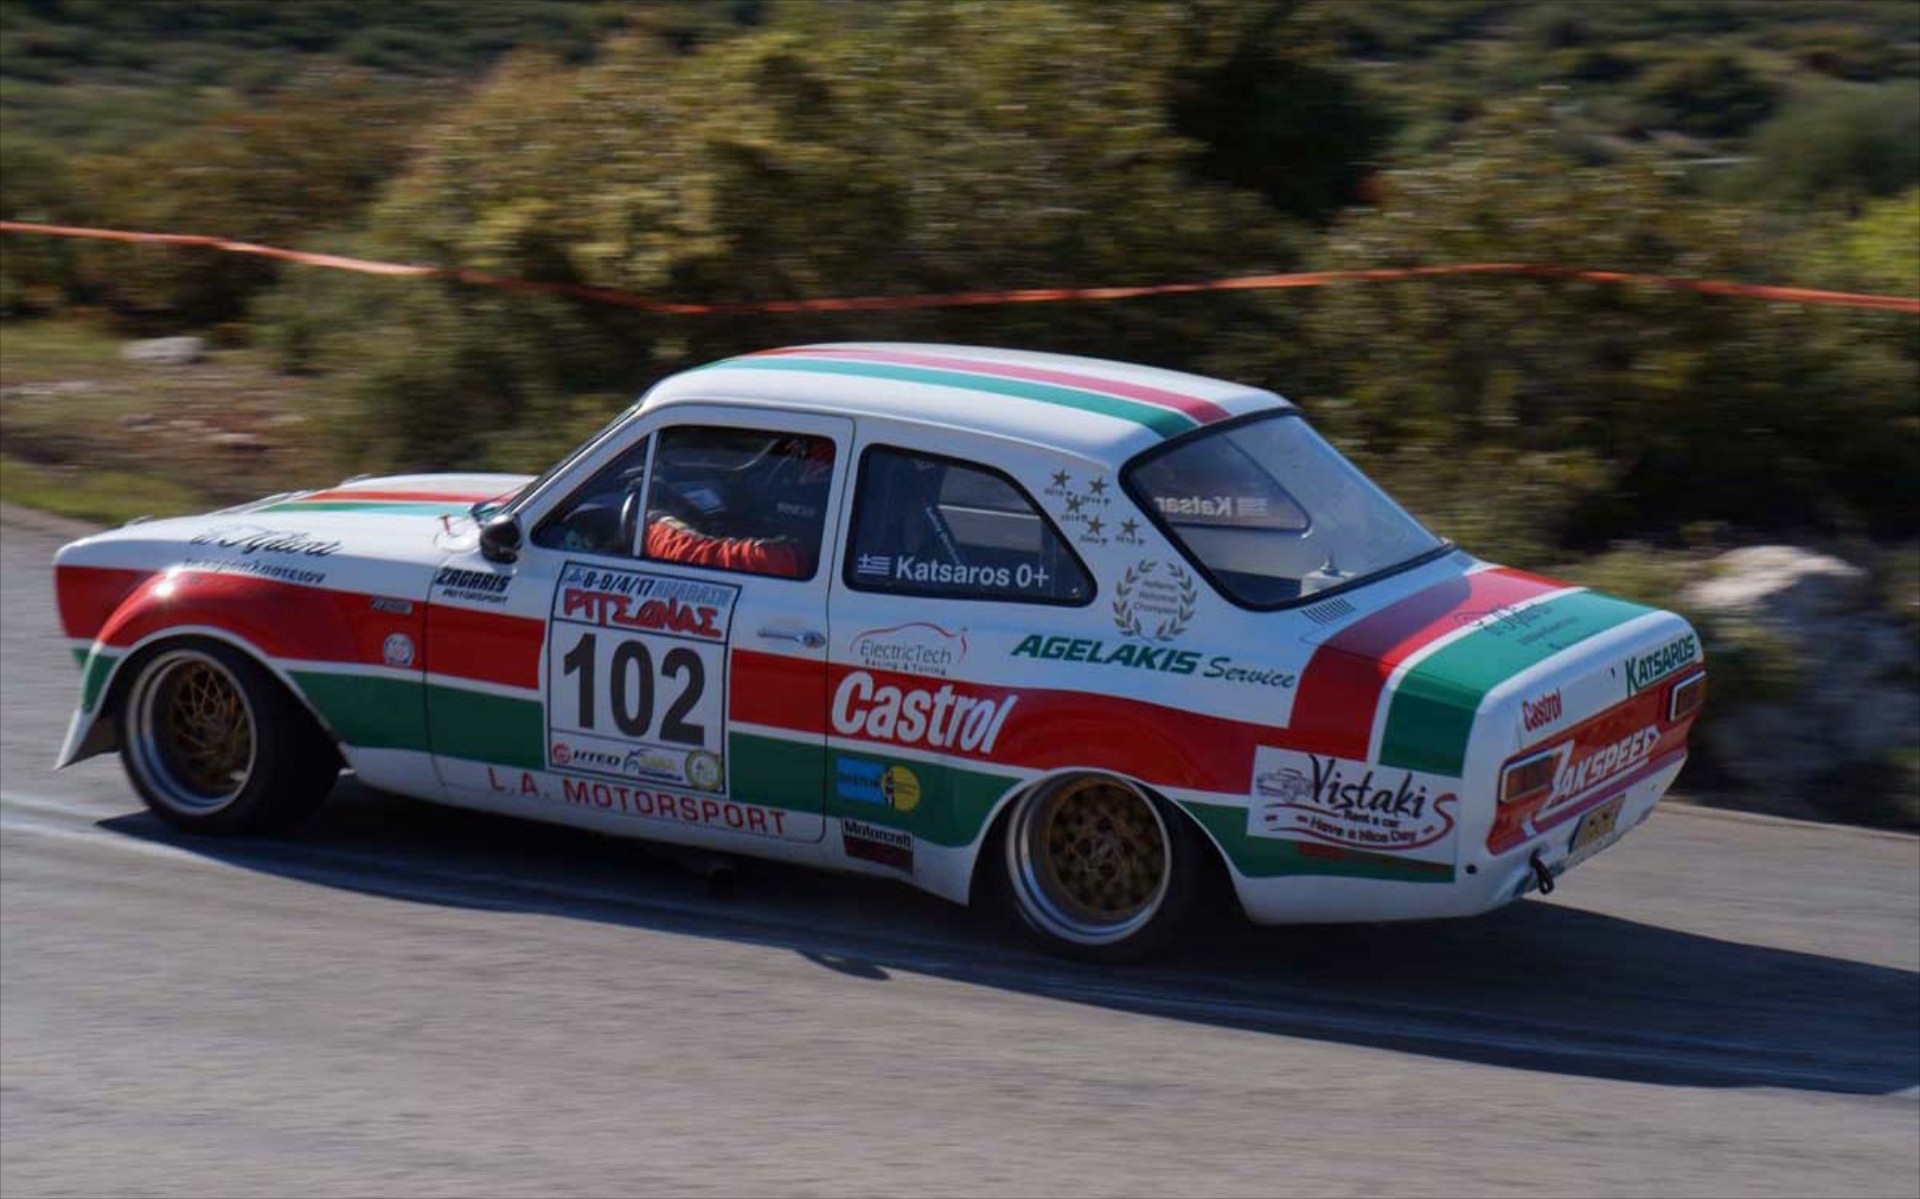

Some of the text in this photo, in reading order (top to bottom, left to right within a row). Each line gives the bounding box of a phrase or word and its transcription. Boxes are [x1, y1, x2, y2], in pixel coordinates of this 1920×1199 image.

[583, 570, 655, 596] 8-9/4/17
[895, 556, 1010, 586] Katsaros
[860, 639, 952, 664] ElectricTech
[1011, 634, 1296, 688] AGELAKIS Service
[1625, 634, 1696, 697] KATSAROS
[564, 632, 705, 747] 102
[832, 671, 1018, 754] Castrol
[1522, 688, 1563, 732] Castrol
[562, 778, 787, 835] MOTORSPORT
